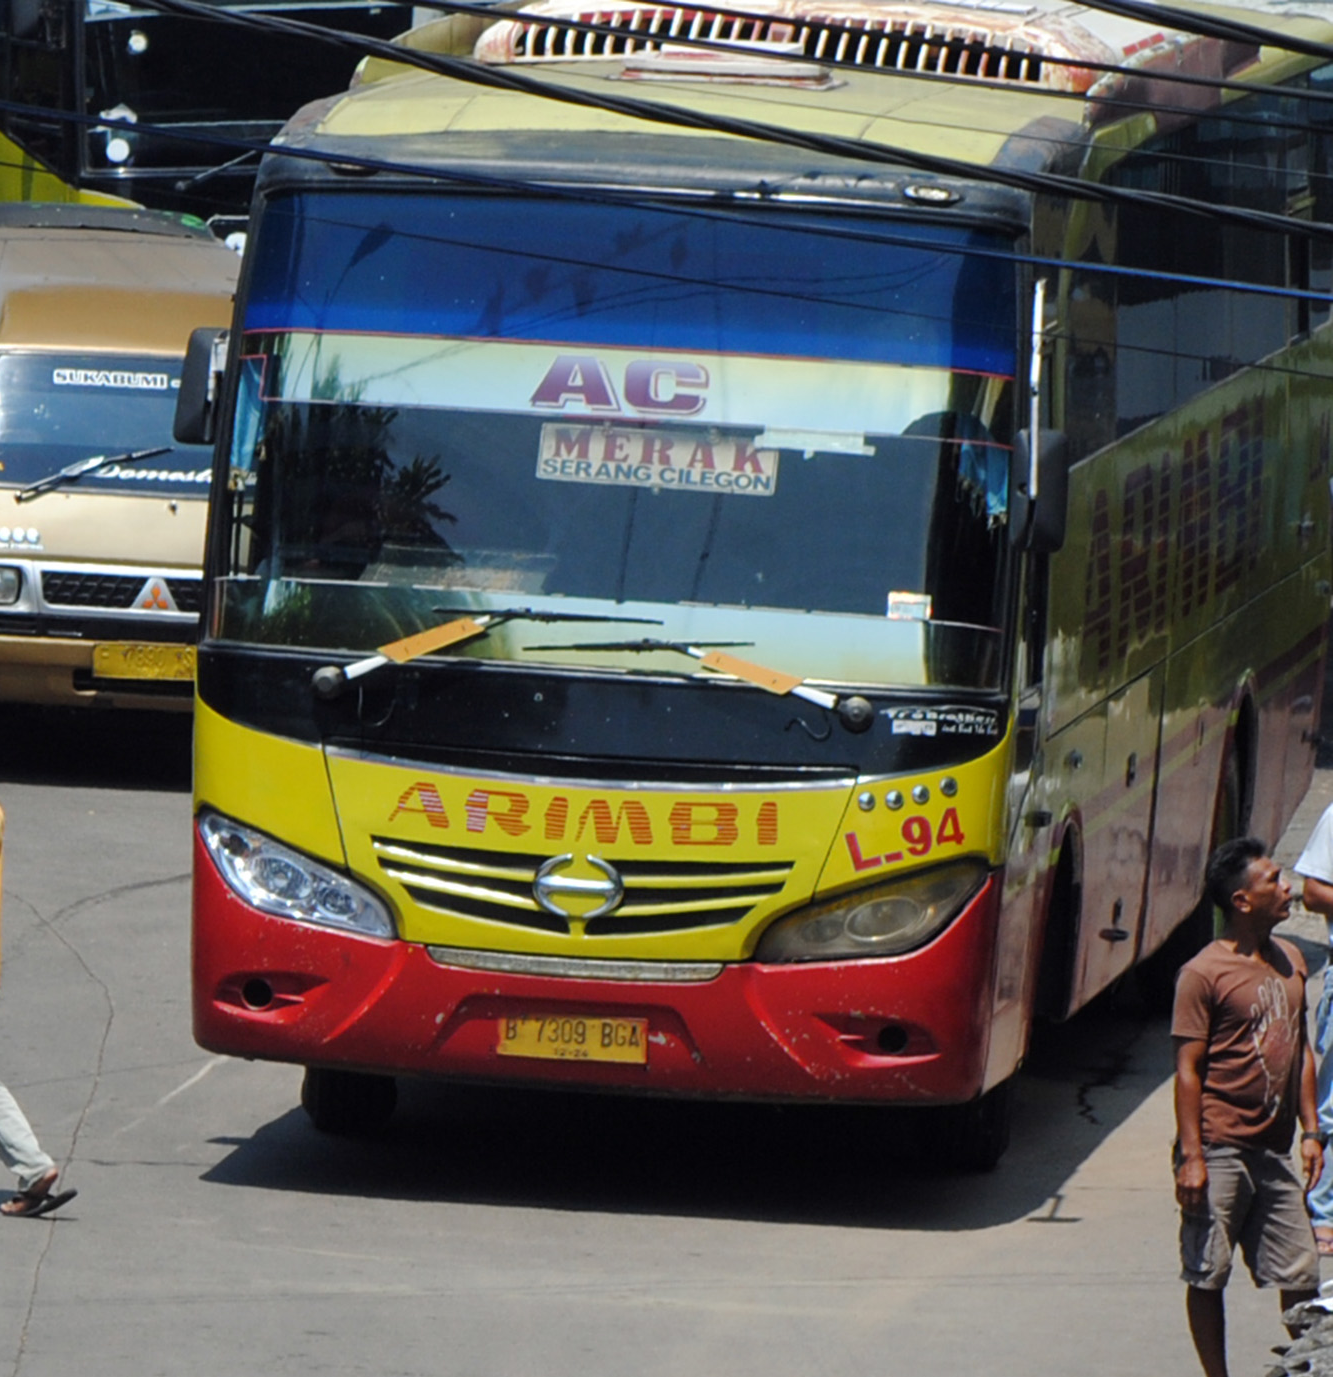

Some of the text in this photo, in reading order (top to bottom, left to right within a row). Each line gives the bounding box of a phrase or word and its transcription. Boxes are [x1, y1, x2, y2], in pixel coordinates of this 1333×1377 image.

[53, 368, 168, 390] SUKABUMI
[528, 354, 710, 416] AC
[552, 426, 765, 474] MERAK
[542, 458, 772, 491] SERANG CILEGON
[387, 781, 778, 846] ARIMBI
[505, 1016, 641, 1048] B 7309 BGA
